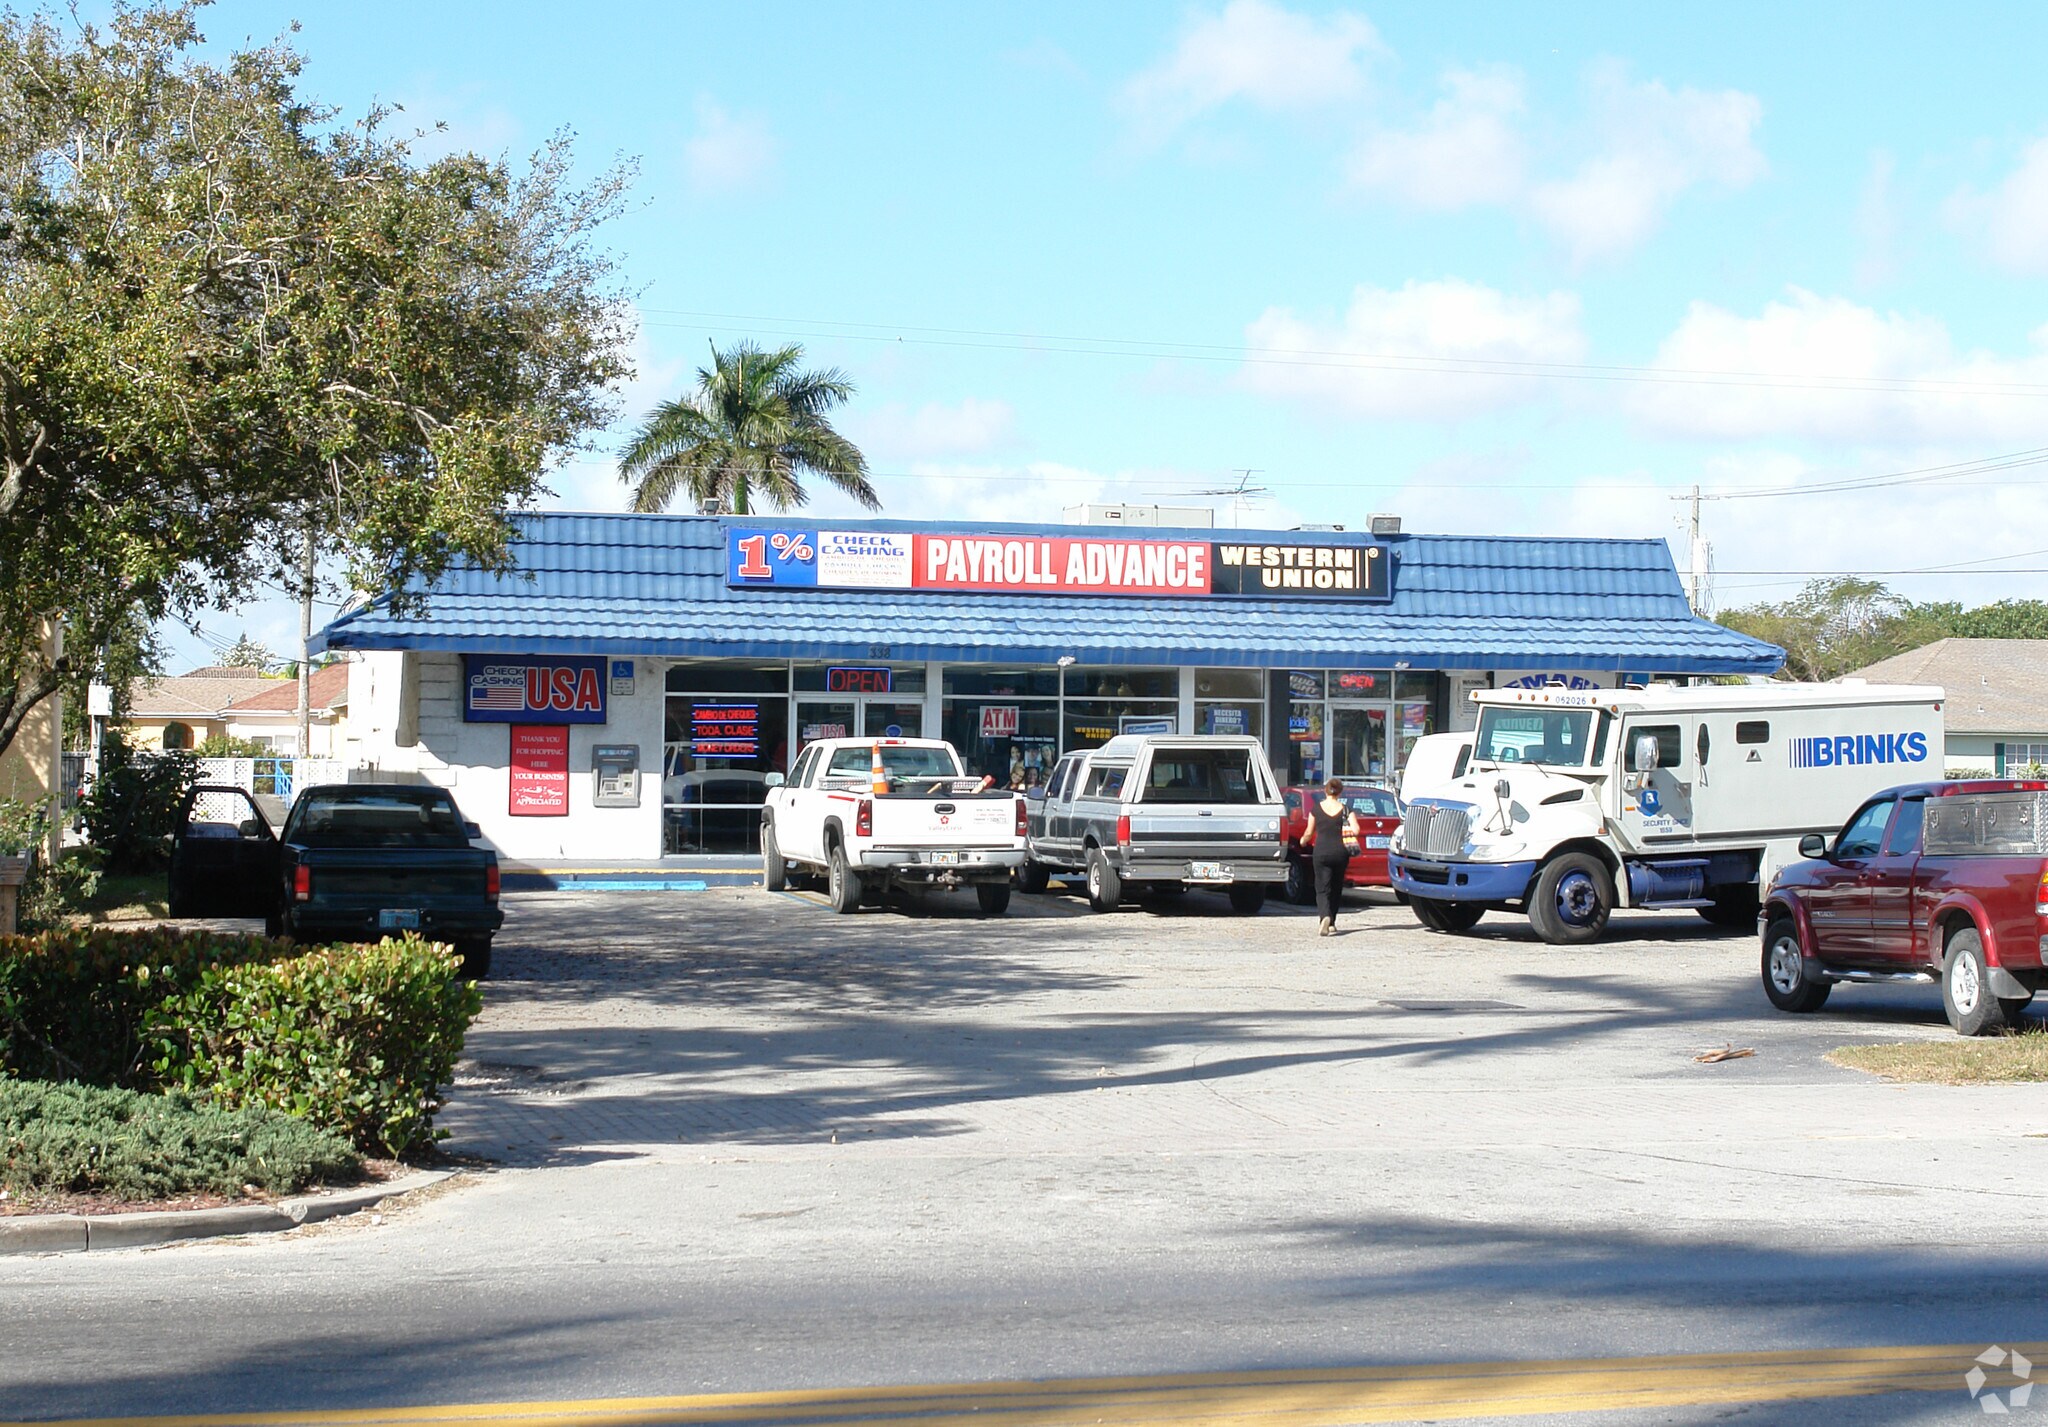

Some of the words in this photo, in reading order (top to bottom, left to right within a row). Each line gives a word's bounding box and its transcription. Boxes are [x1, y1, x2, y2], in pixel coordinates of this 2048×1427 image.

[832, 535, 892, 546] CHECK
[738, 533, 814, 578] 1%
[821, 545, 905, 556] CASHING
[1219, 545, 1354, 568] WESTERN
[927, 538, 1059, 585] PAYROLL
[1064, 542, 1206, 588] ADVANCE
[1261, 567, 1354, 590] UNION
[484, 666, 525, 676] CHECK
[470, 676, 525, 686] CASHING
[829, 669, 889, 693] OPEN
[1339, 674, 1375, 689] OPEN
[525, 666, 602, 711] USA
[1555, 695, 1587, 706] 062026
[728, 709, 756, 720] CHEQUES
[982, 707, 1017, 728] ATM
[1213, 709, 1242, 718] NECESITA
[697, 725, 721, 736] TODA
[724, 725, 755, 736] CLASE
[820, 724, 847, 738] USA
[724, 743, 755, 753] ORDERS
[1813, 732, 1927, 767] BRINKS
[534, 773, 565, 781] BUSINESS
[515, 798, 562, 806] APPRECIATED
[1643, 819, 1671, 827] SECURITY
